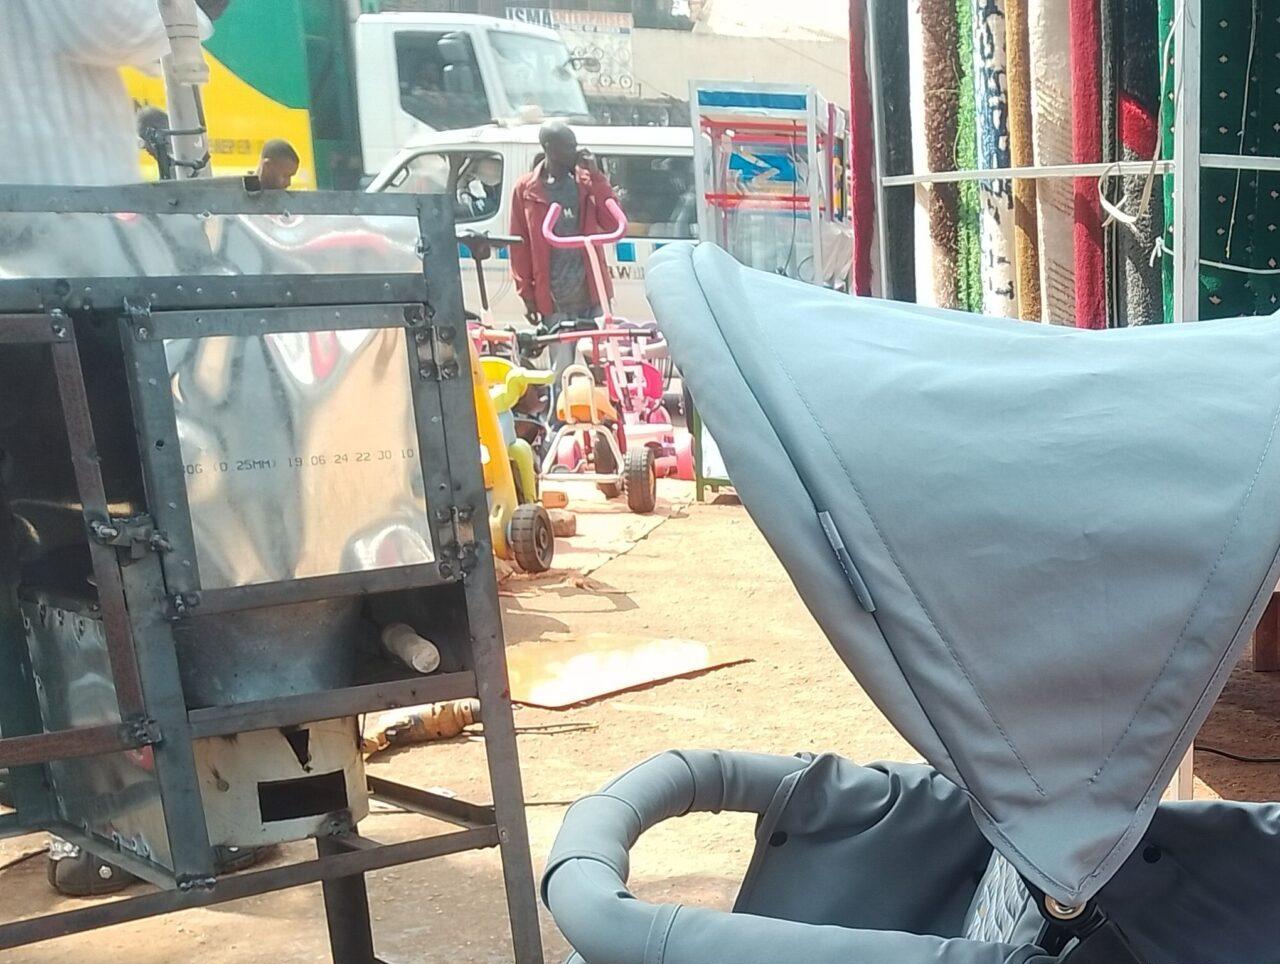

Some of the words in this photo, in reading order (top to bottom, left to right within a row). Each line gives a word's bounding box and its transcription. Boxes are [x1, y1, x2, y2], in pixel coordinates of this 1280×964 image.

[310, 455, 326, 466] 06
[334, 453, 348, 464] 24
[355, 452, 371, 462] 22
[401, 448, 414, 459] 10
